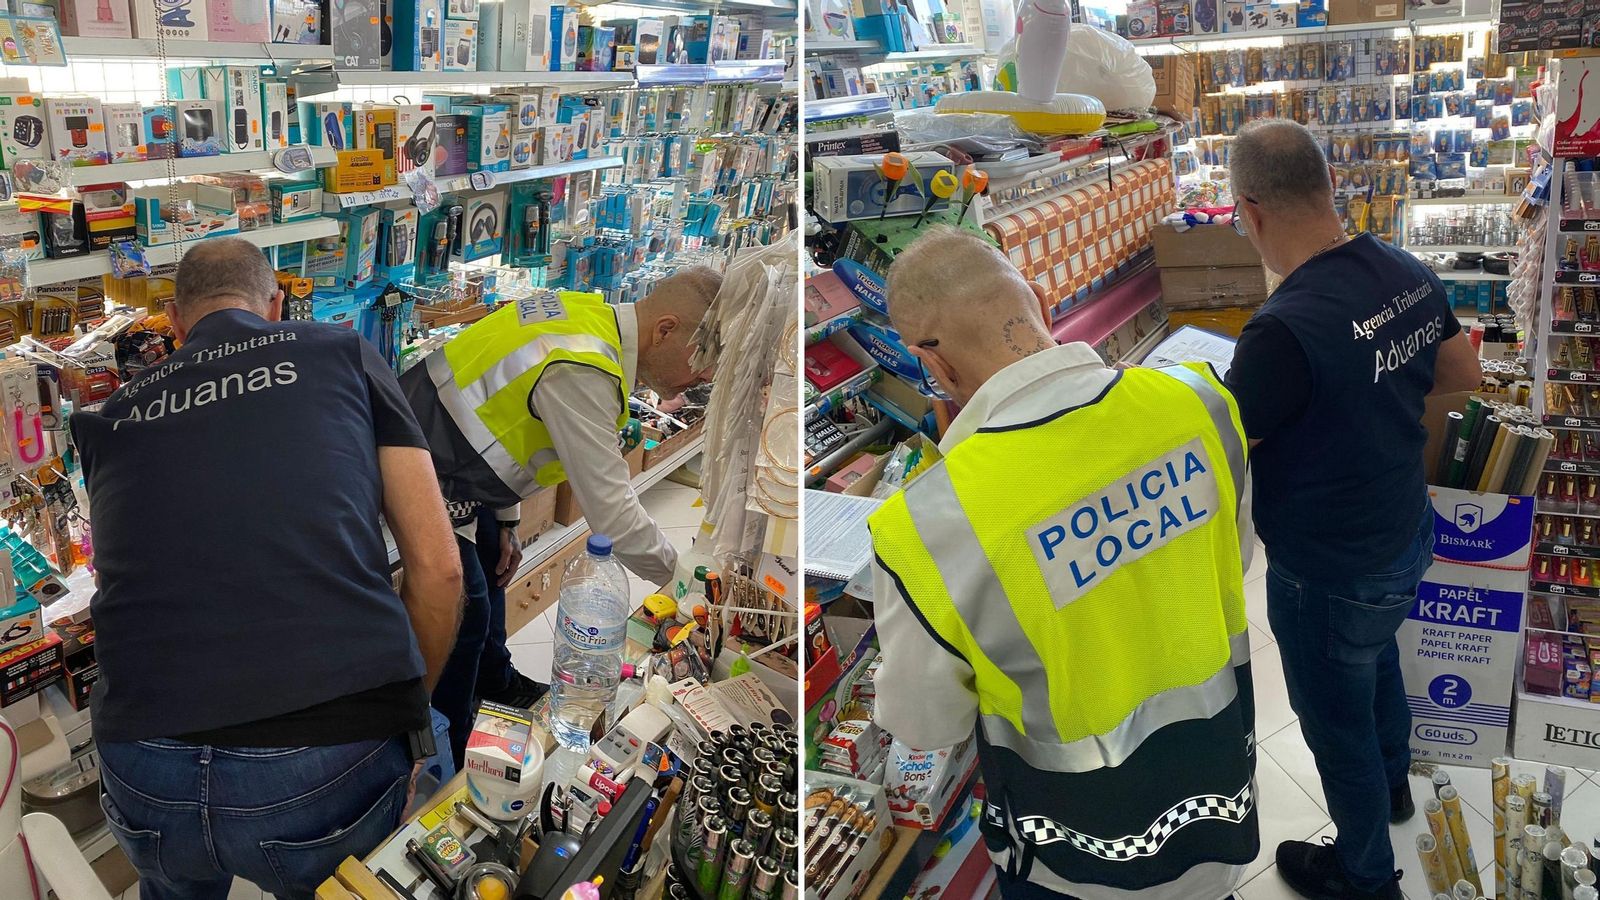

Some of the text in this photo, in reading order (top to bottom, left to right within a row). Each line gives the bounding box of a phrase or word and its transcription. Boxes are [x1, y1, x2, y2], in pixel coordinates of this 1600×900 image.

[345, 56, 360, 67] CAT
[251, 69, 259, 94] SANDA
[818, 141, 847, 152] Printex
[150, 267, 177, 276] Panason
[37, 286, 76, 294] Panasonic
[854, 283, 883, 306] HALLS
[1352, 280, 1433, 340] Agencia Tributaria
[870, 335, 902, 358] Trident
[1374, 316, 1442, 383] Aduanas
[869, 346, 898, 368] HALLS
[86, 366, 106, 375] CR123
[118, 330, 297, 401] Agencia Tributaria
[112, 361, 298, 431] Aduanas
[808, 418, 827, 432] HALLS
[815, 424, 836, 439] HALLS
[822, 431, 843, 446] HALLS
[1038, 451, 1206, 561] POLICIA
[1069, 495, 1207, 588] LOCAL
[1440, 588, 1483, 602] PAPEL
[1419, 599, 1502, 626] KRAFT
[1422, 627, 1492, 643] KRAFT PAPER
[0, 637, 48, 664] RASTA
[1421, 638, 1489, 653] PAPEL KRAFT
[1417, 649, 1491, 664] PAPIER KRAFT
[1443, 679, 1458, 696] 2
[1442, 697, 1456, 705] m.
[1425, 729, 1468, 741] 60 uds.
[511, 744, 522, 753] 40
[467, 758, 504, 779] Marlboro
[904, 772, 926, 782] Bons
